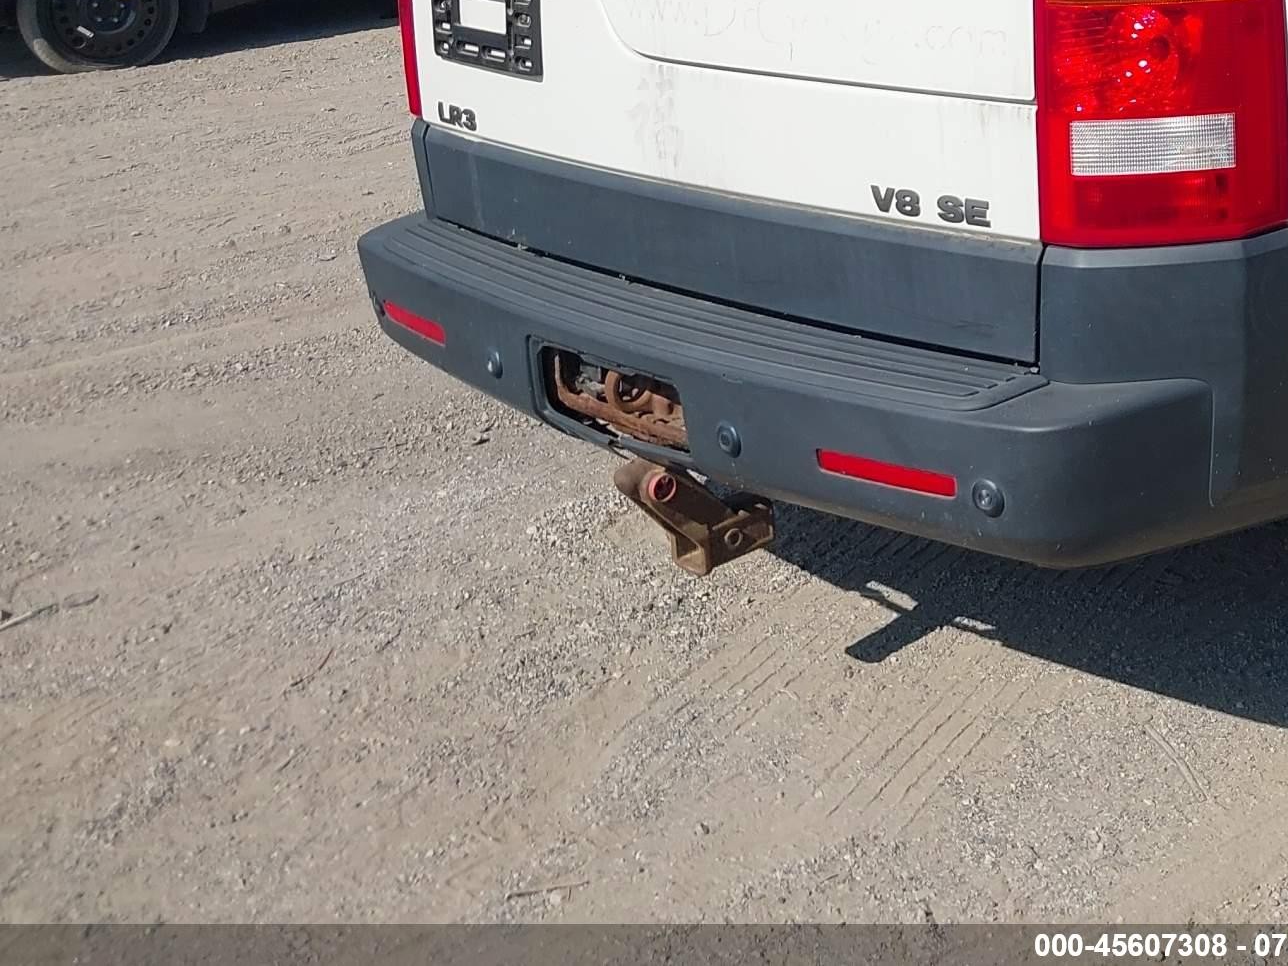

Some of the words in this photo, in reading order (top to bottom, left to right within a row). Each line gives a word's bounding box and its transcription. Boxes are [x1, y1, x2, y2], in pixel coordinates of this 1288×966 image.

[437, 101, 477, 132] LR3
[870, 184, 921, 217] V8
[937, 195, 992, 229] SE
